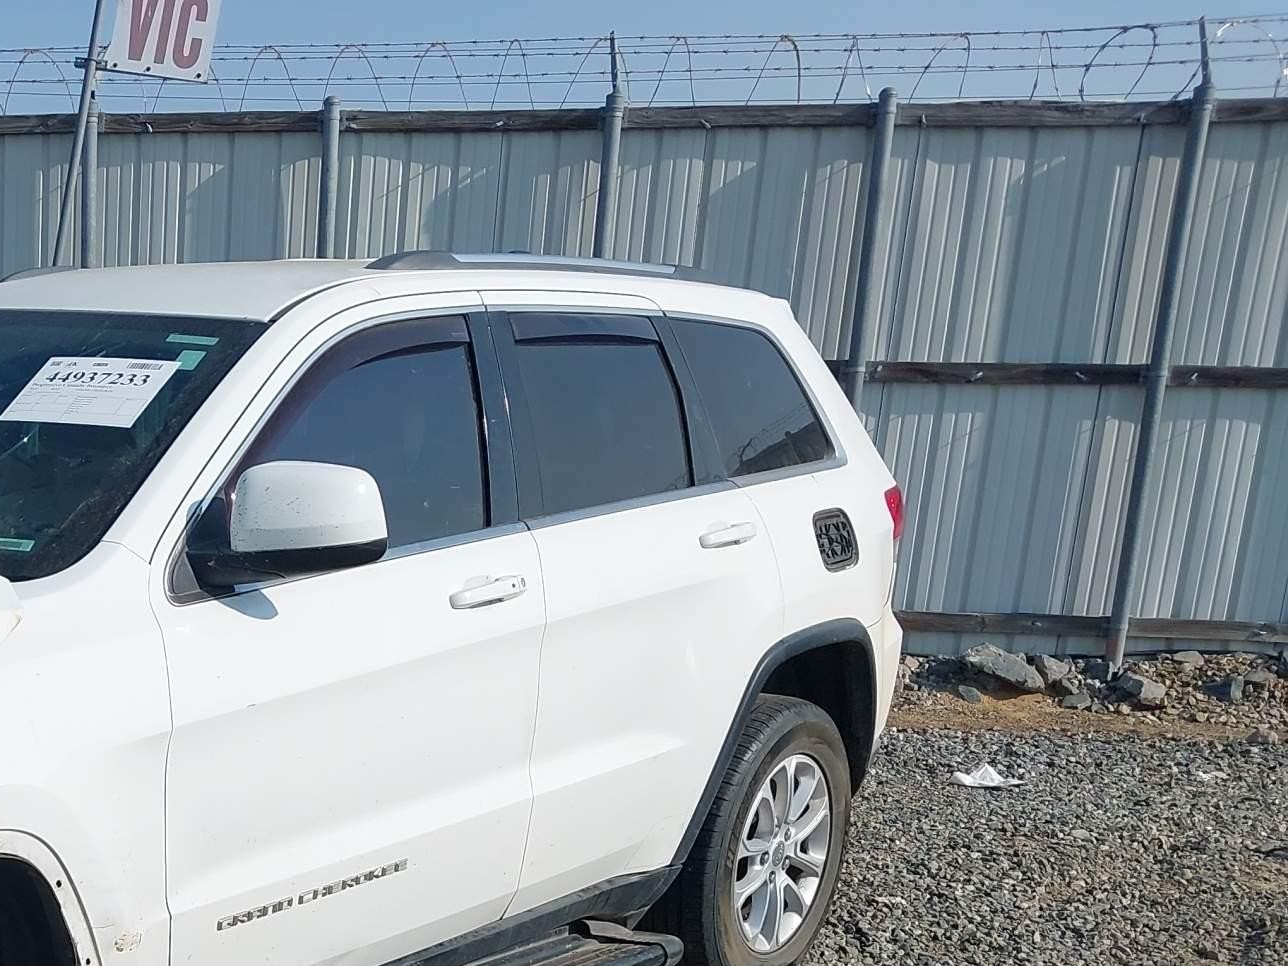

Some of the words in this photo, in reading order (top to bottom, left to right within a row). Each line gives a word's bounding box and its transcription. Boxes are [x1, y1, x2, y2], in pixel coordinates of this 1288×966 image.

[128, 0, 209, 69] VIC
[45, 371, 151, 386] 44937233
[216, 896, 294, 932] GRAND
[297, 857, 409, 905] CHEROKEE
